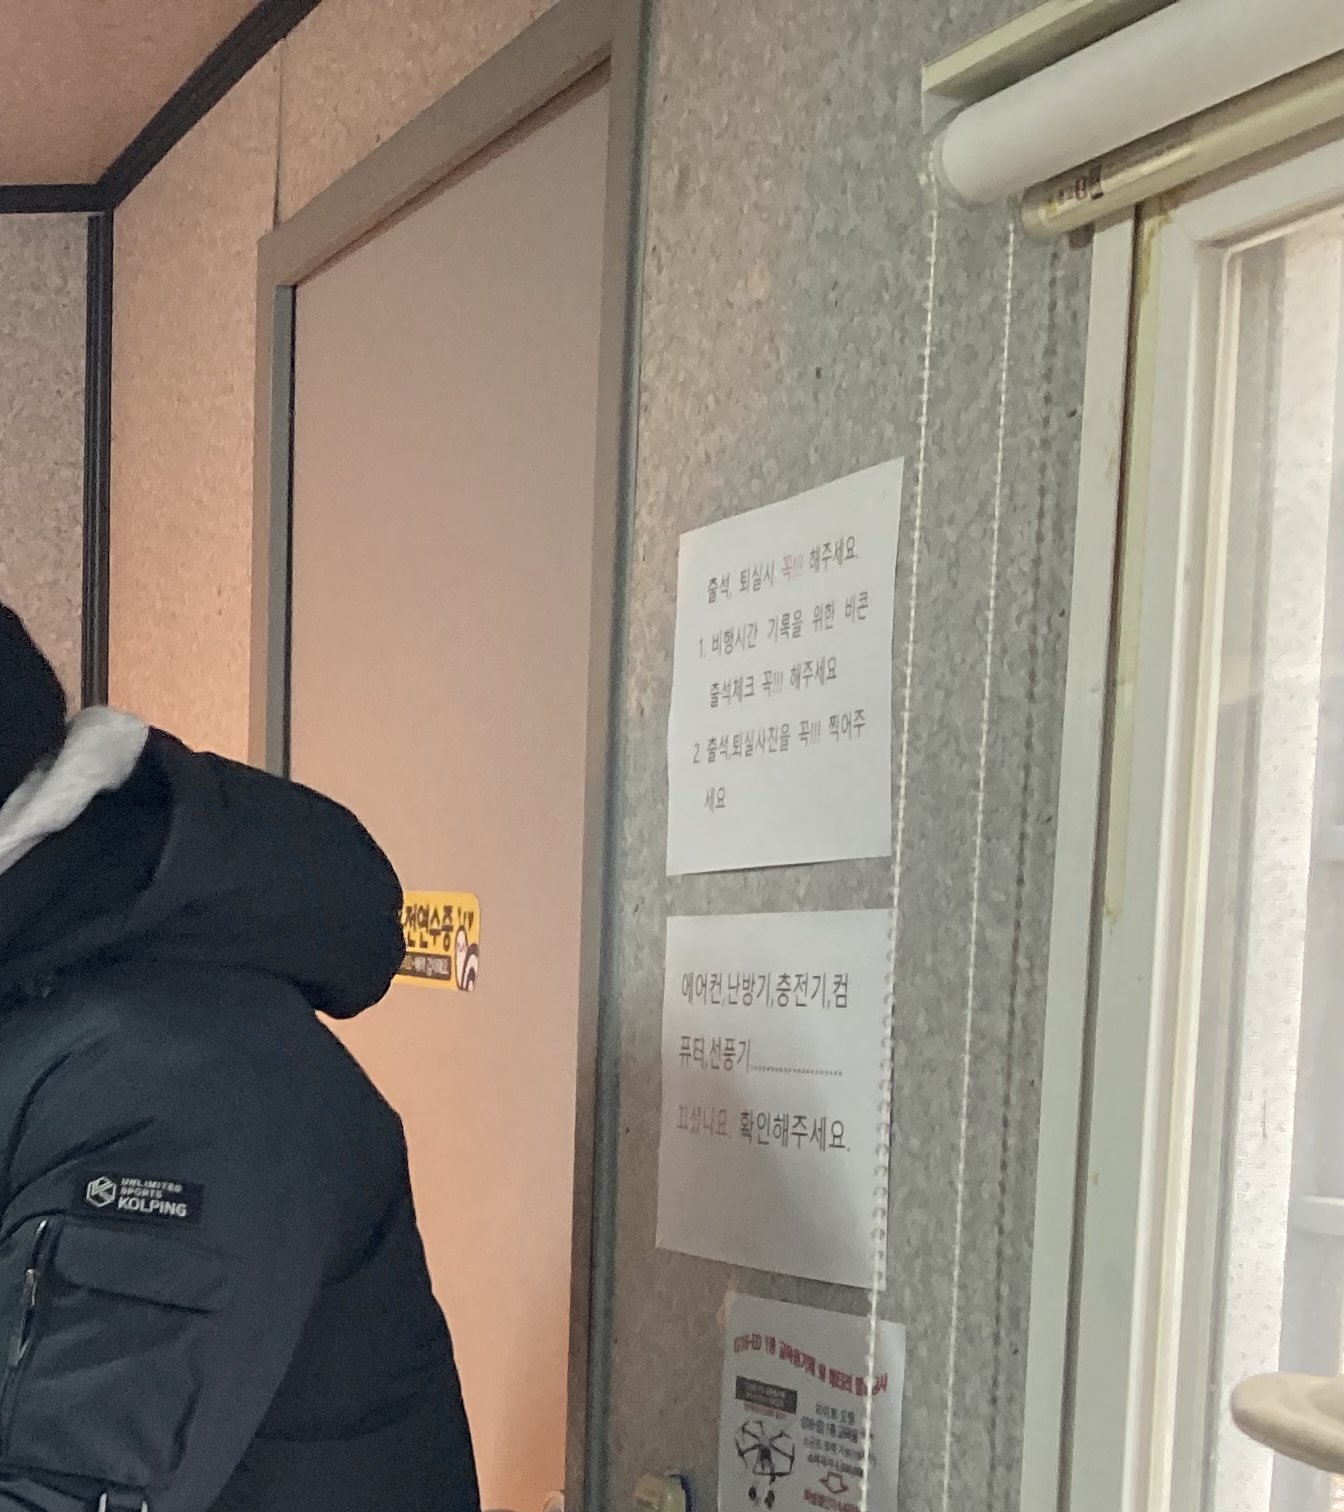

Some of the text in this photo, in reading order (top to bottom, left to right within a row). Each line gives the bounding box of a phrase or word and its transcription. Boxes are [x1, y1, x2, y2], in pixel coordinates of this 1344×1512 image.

[739, 559, 775, 593] 퇴실시
[712, 621, 758, 656] 비행시간
[767, 609, 803, 642] 기록을
[812, 601, 835, 632] 위한
[844, 591, 869, 623] 비콘
[710, 675, 755, 708] 출석체크
[790, 656, 837, 690] 해주세요
[828, 709, 865, 741] 찍어주
[704, 786, 726, 813] 세요
[118, 1196, 188, 1217] KOLPING
